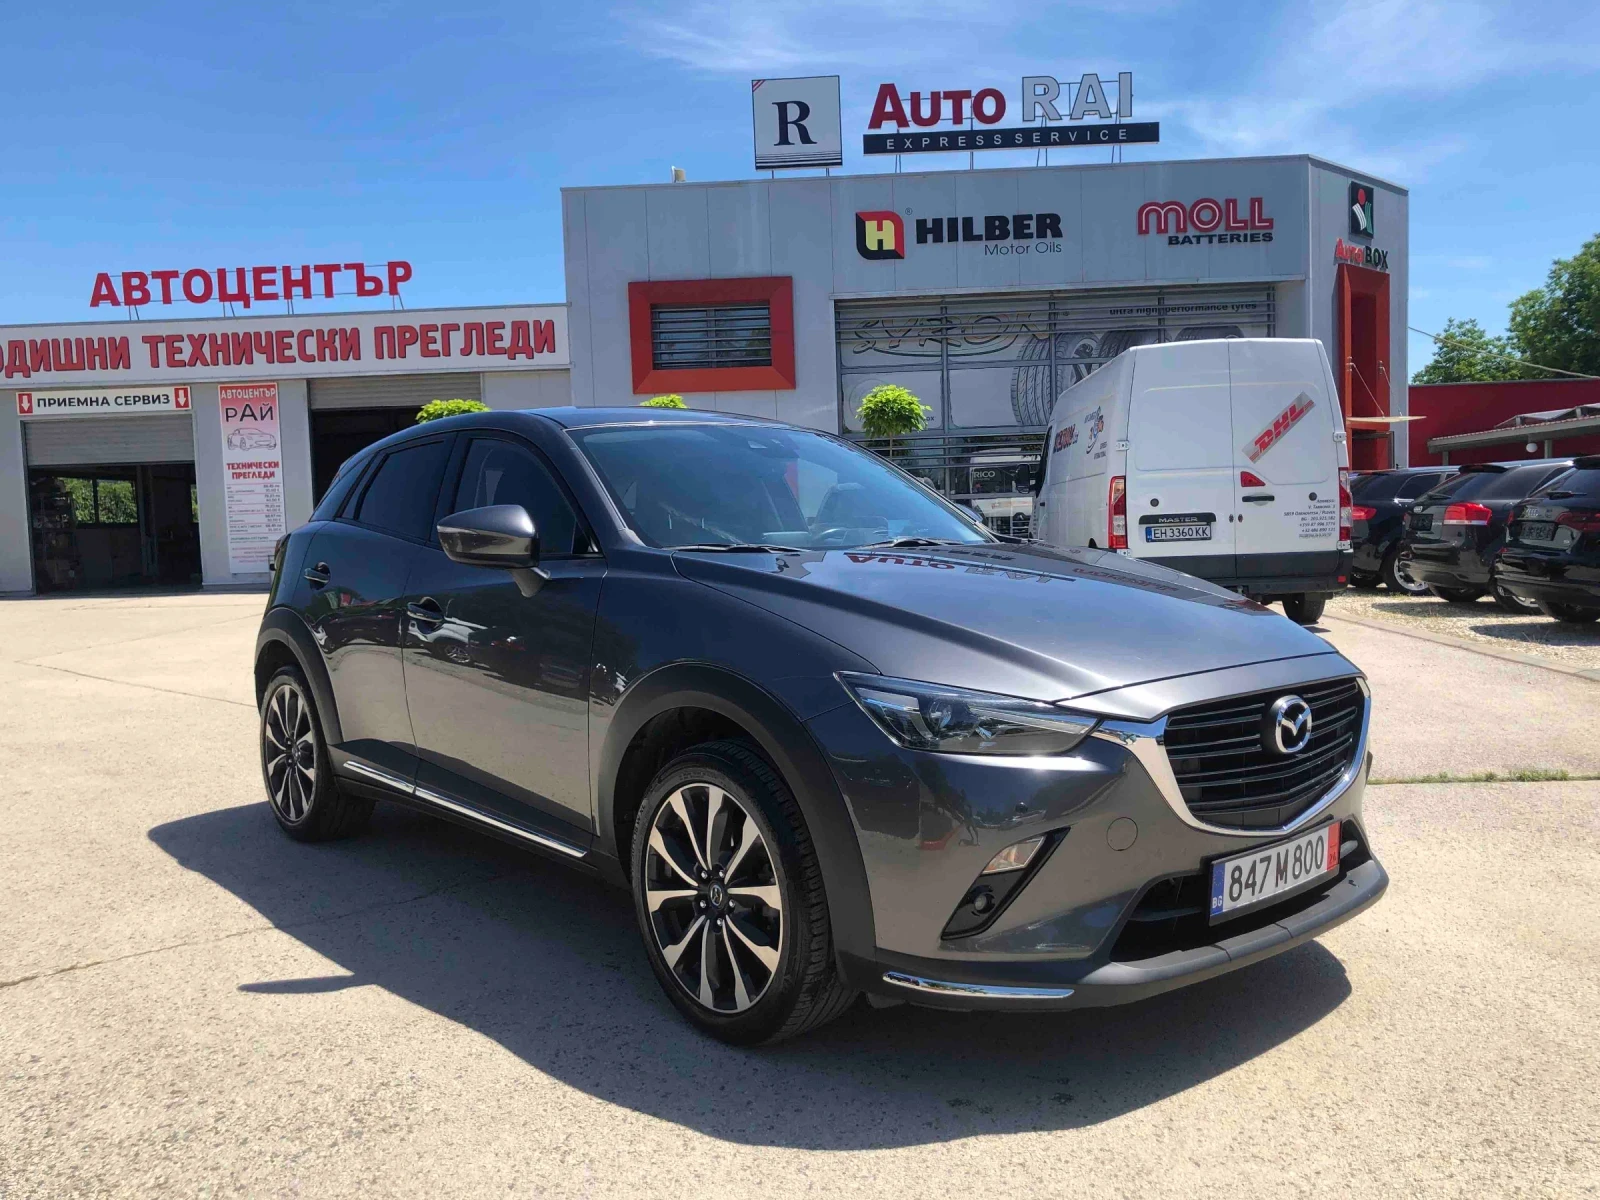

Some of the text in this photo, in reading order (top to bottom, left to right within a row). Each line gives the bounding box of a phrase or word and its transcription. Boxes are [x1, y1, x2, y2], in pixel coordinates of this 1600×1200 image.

[868, 72, 1133, 130] AUTO RAI
[772, 100, 817, 147] R
[886, 129, 1127, 150] EXPRESS SERVICE
[915, 213, 1063, 244] HILBER
[1168, 232, 1274, 246] BATTERIES
[984, 241, 1062, 256] Motor Oils
[90, 261, 412, 309] АВТОЦЕНТЪР
[0, 319, 556, 378] ДИШНИ ТЕХНИЧЕСКИ ПРЕГЛЕДИ
[37, 393, 170, 408] ПРИЕМНА СЕРВИЗ
[221, 387, 276, 400] АВТОЦЕНТЪР
[225, 402, 274, 423] РАЙ
[1254, 403, 1305, 454] DHL
[226, 461, 280, 471] ТЕХНИЧЕСКИ
[232, 471, 276, 480] ПРЕГЛЕДИ
[1153, 526, 1209, 539] EH 3360 KK
[1212, 896, 1223, 909] BG
